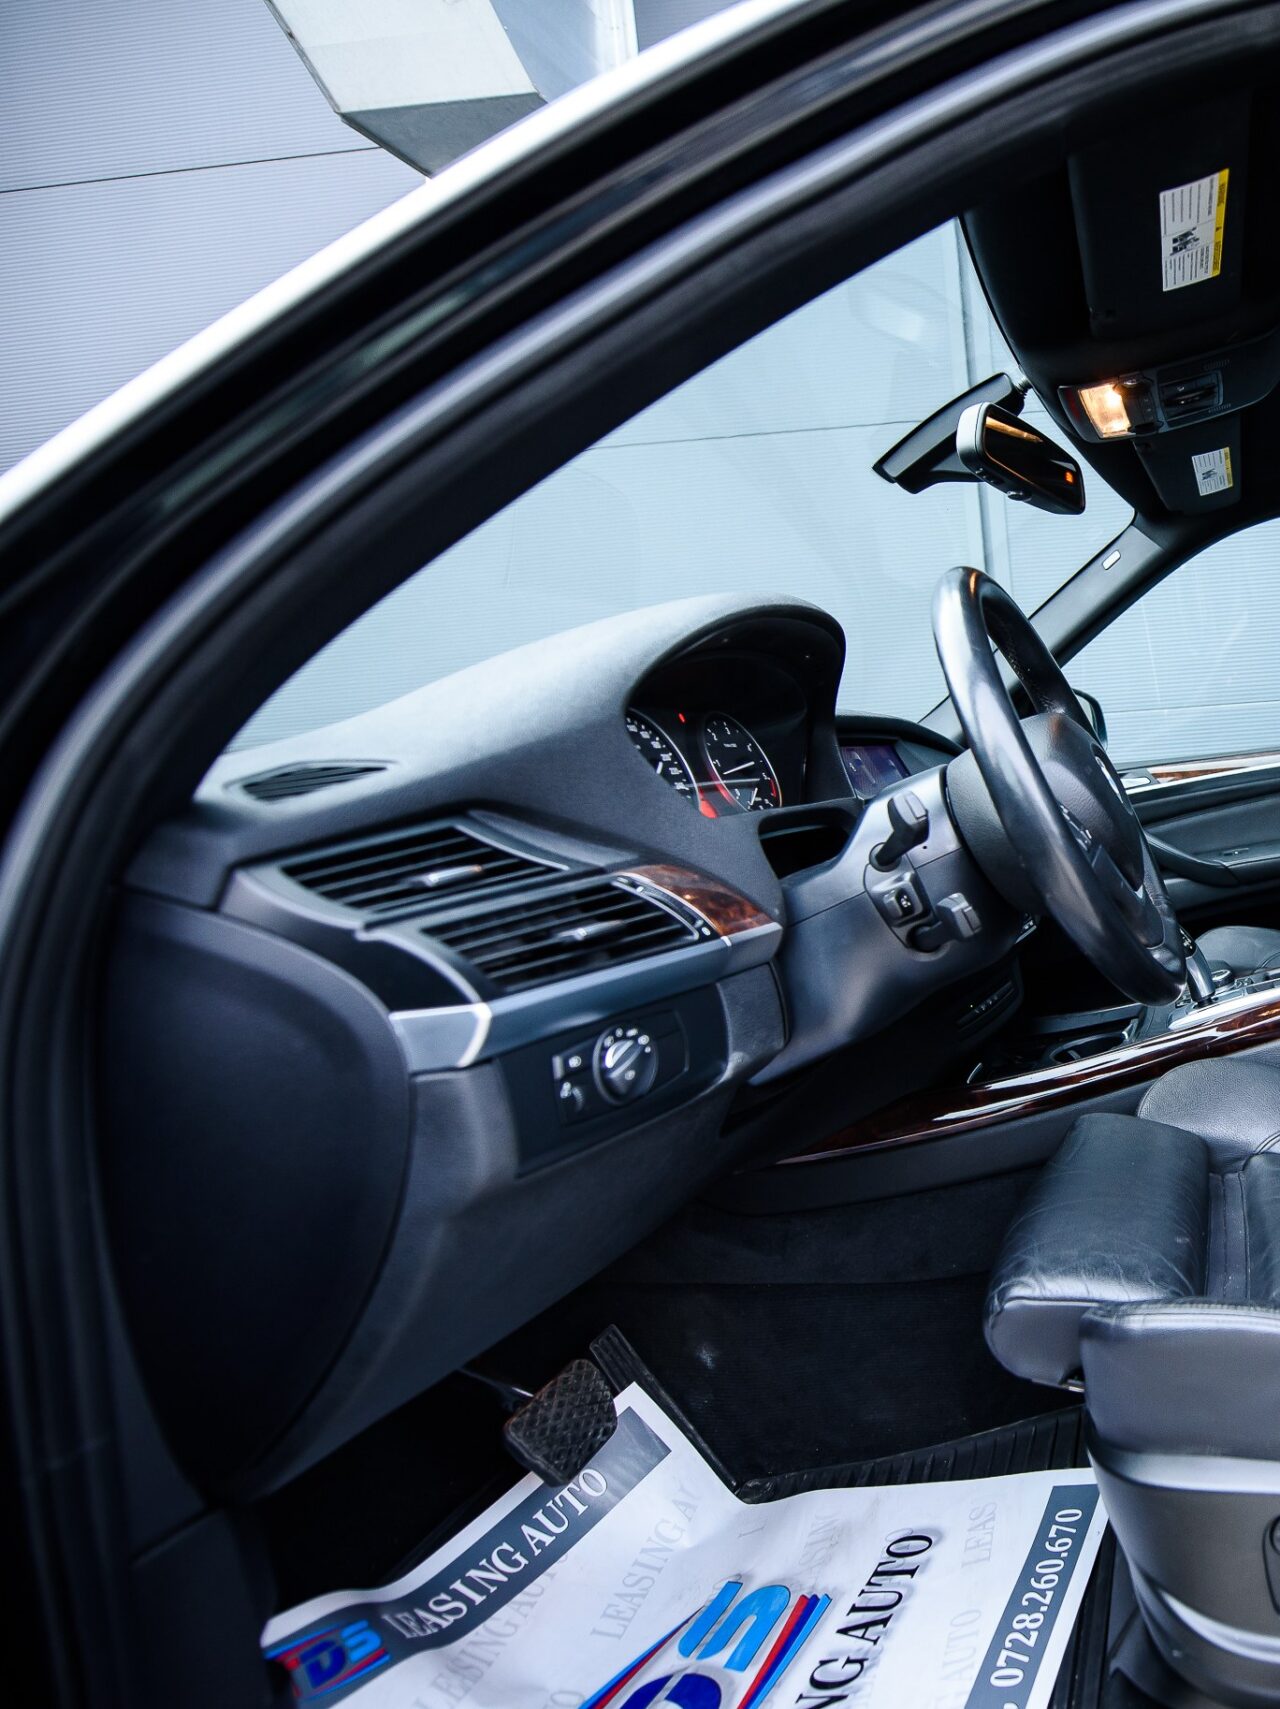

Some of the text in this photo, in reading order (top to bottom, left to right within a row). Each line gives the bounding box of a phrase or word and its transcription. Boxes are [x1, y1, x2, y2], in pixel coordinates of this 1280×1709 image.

[381, 1468, 607, 1638] LEASING AUTO
[590, 1518, 686, 1640] LEASING
[835, 1534, 933, 1646] AUTO
[990, 1509, 1082, 1688] 0728.260.670
